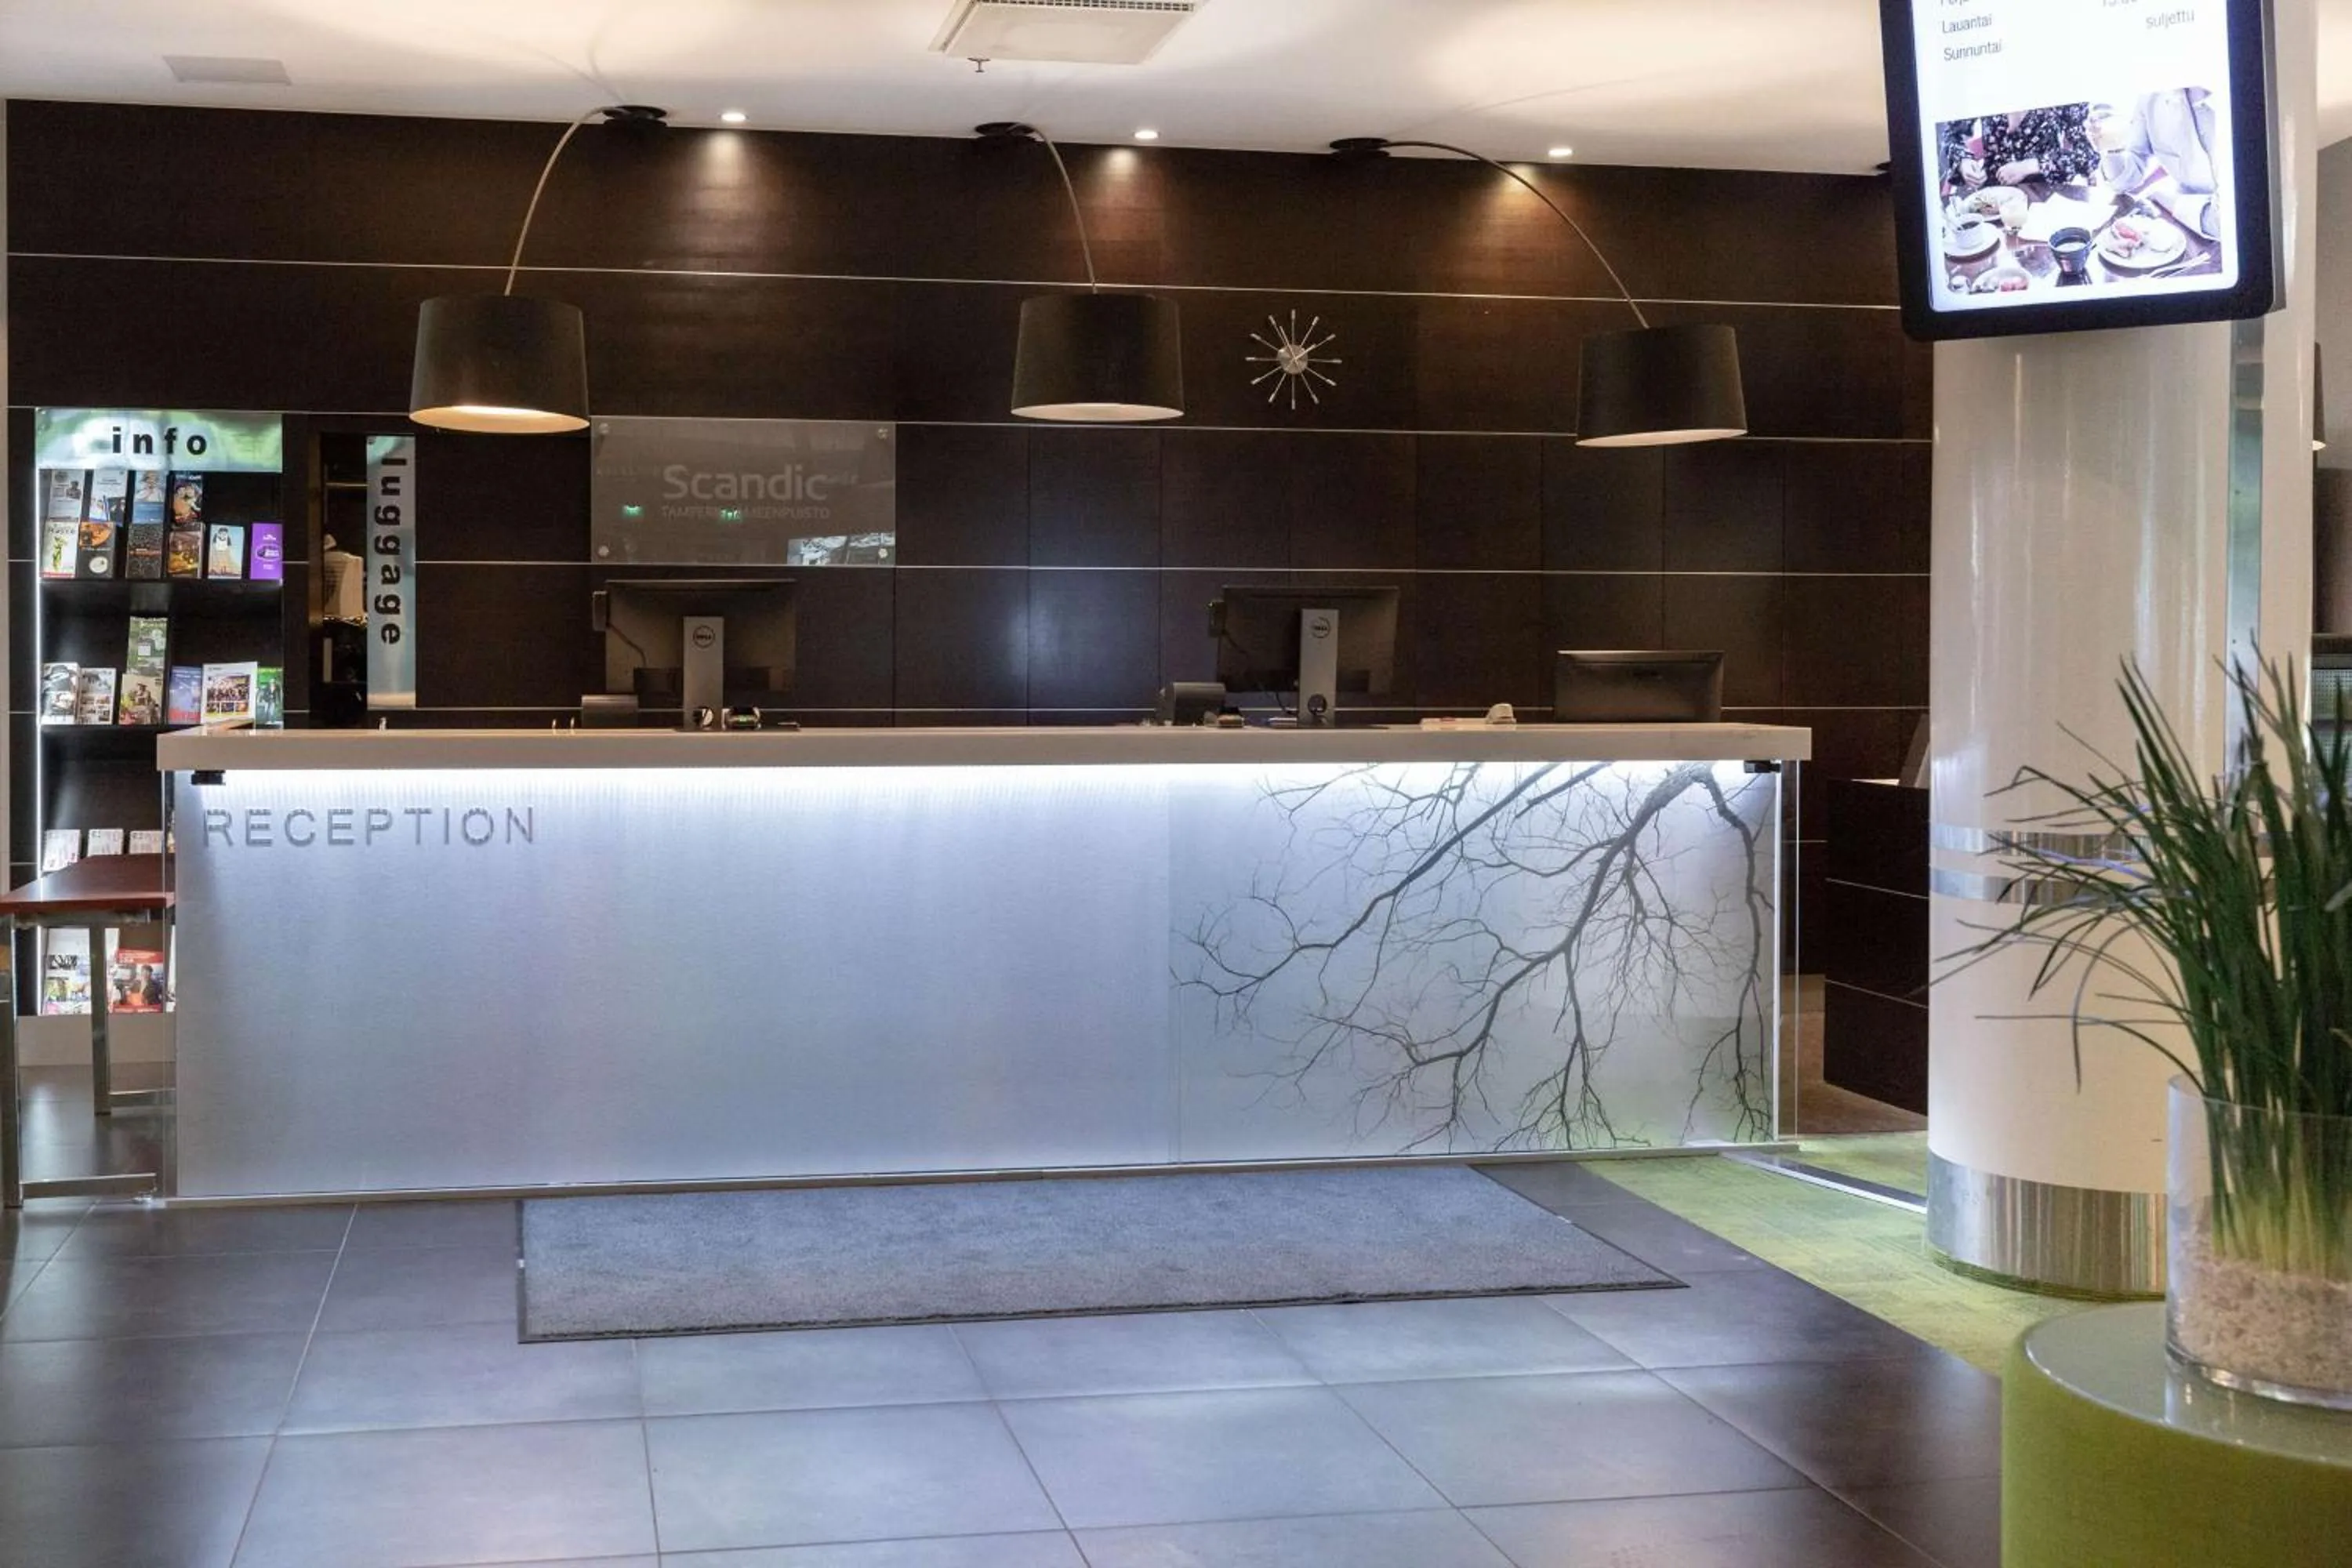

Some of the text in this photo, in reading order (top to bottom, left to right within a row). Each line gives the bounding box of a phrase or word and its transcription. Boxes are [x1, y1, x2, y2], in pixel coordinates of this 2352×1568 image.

[1941, 13, 1992, 33] Lauantai
[1944, 38, 2002, 60] Sunnuntai
[112, 426, 207, 456] info
[662, 464, 829, 501] Scandic
[374, 457, 407, 645] luggage
[203, 807, 534, 847] RECEPTION
